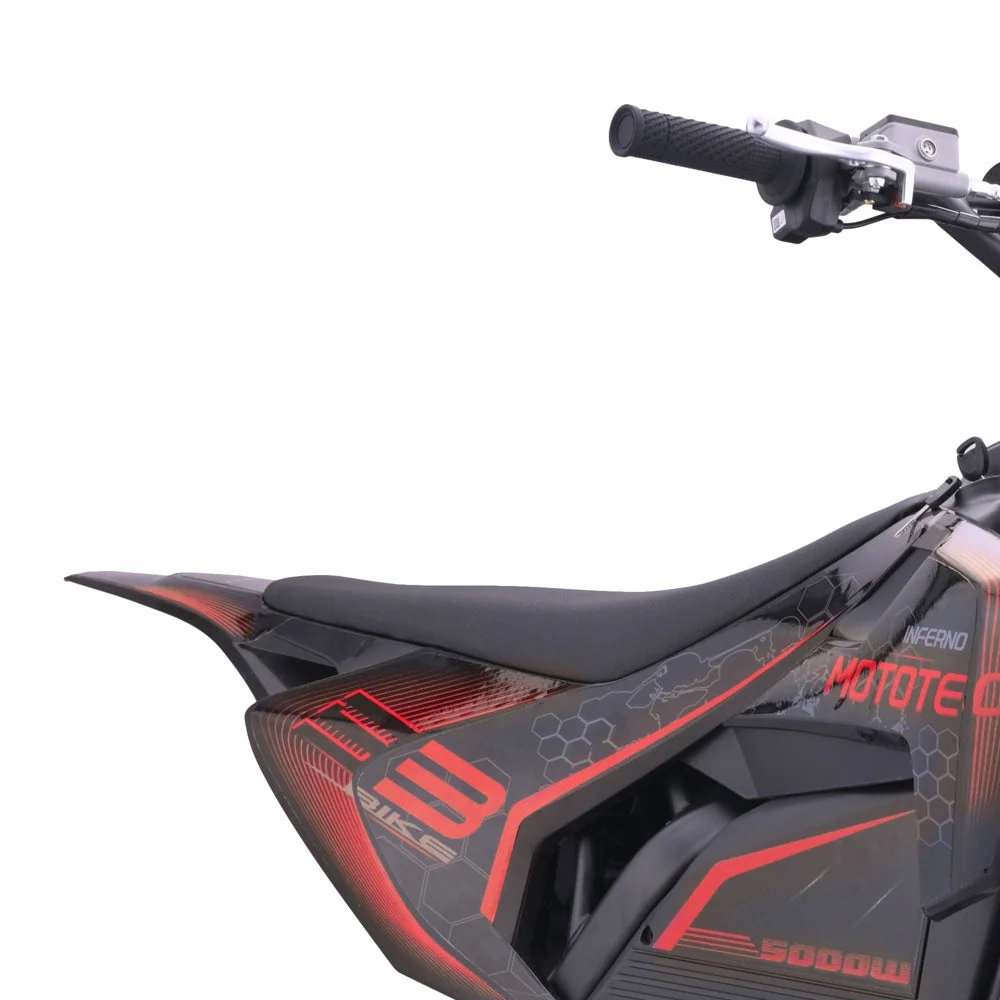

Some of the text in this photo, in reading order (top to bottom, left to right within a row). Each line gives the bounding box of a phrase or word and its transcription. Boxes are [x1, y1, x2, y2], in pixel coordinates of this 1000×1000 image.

[903, 625, 968, 651] INFERNO
[350, 783, 458, 865] BIKE
[760, 938, 911, 984] 5000W
